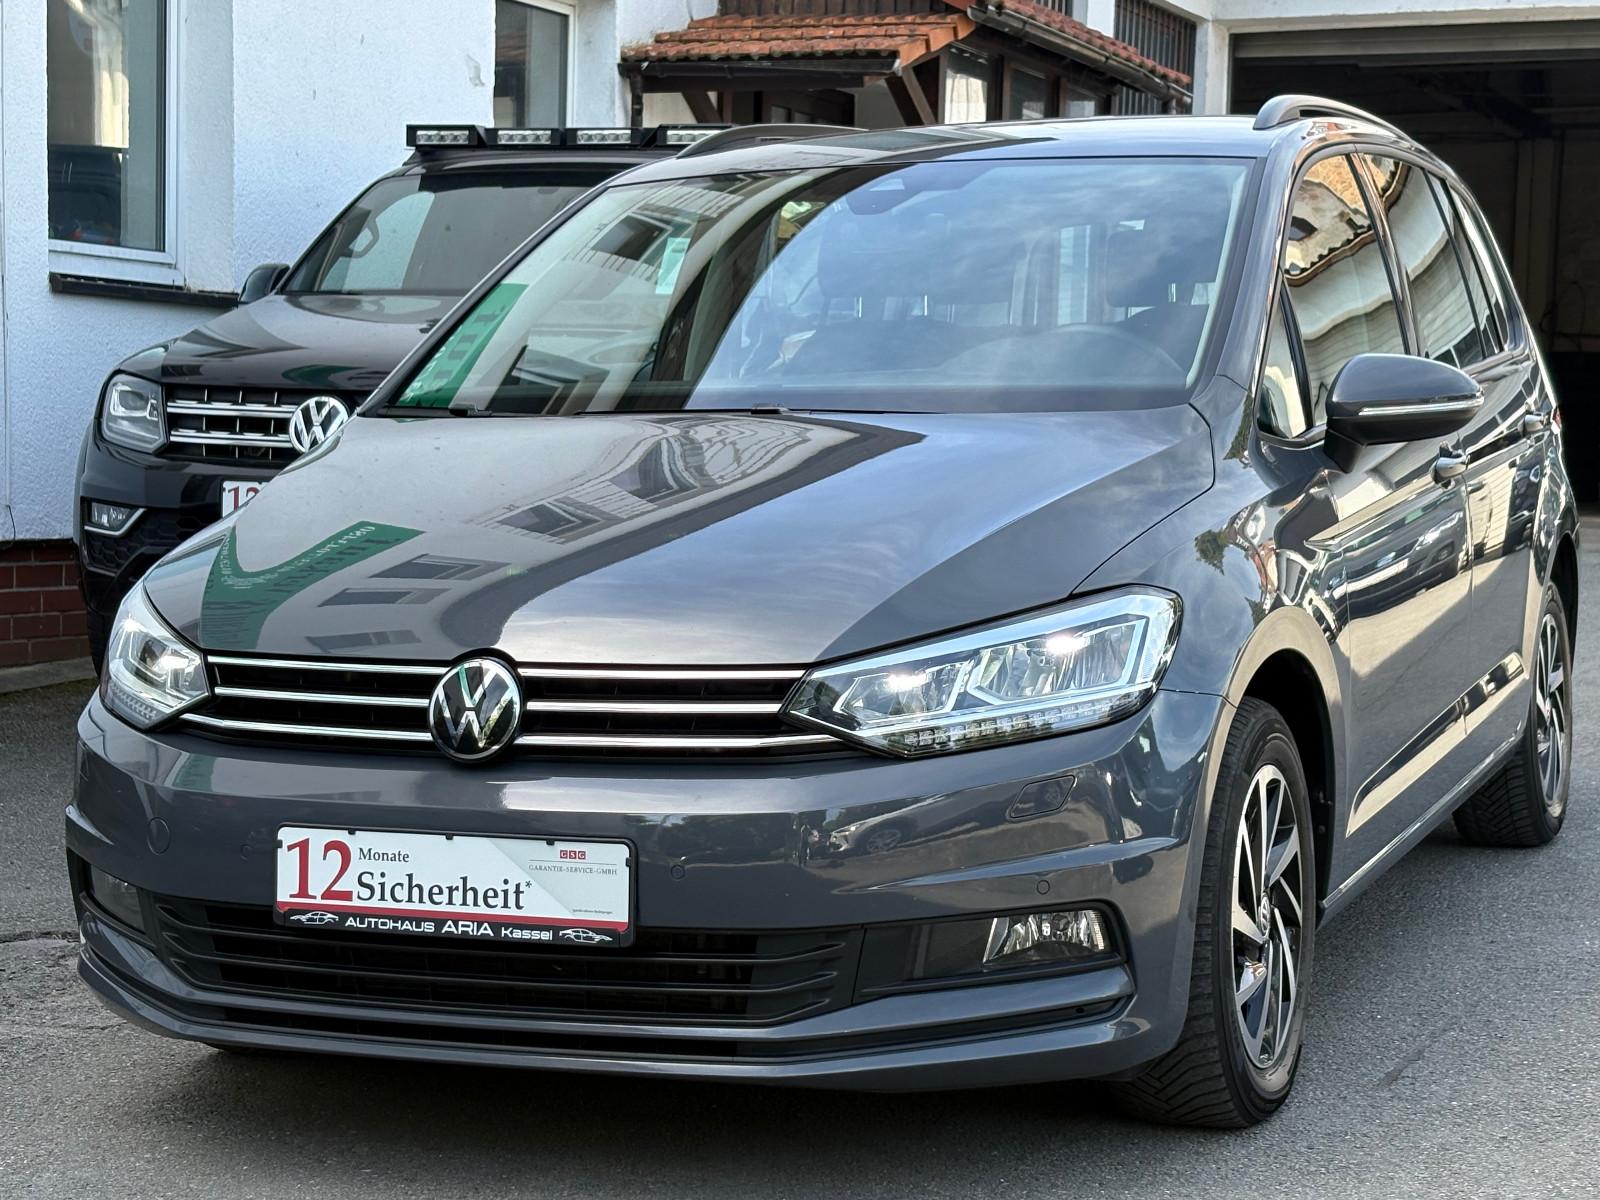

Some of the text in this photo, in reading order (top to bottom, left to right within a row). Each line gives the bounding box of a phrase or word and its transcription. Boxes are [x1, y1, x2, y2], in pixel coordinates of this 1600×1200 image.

[359, 848, 410, 862] Monate
[287, 838, 353, 901] 12
[345, 917, 553, 940] AUTOHAUS ARIA Kassel
